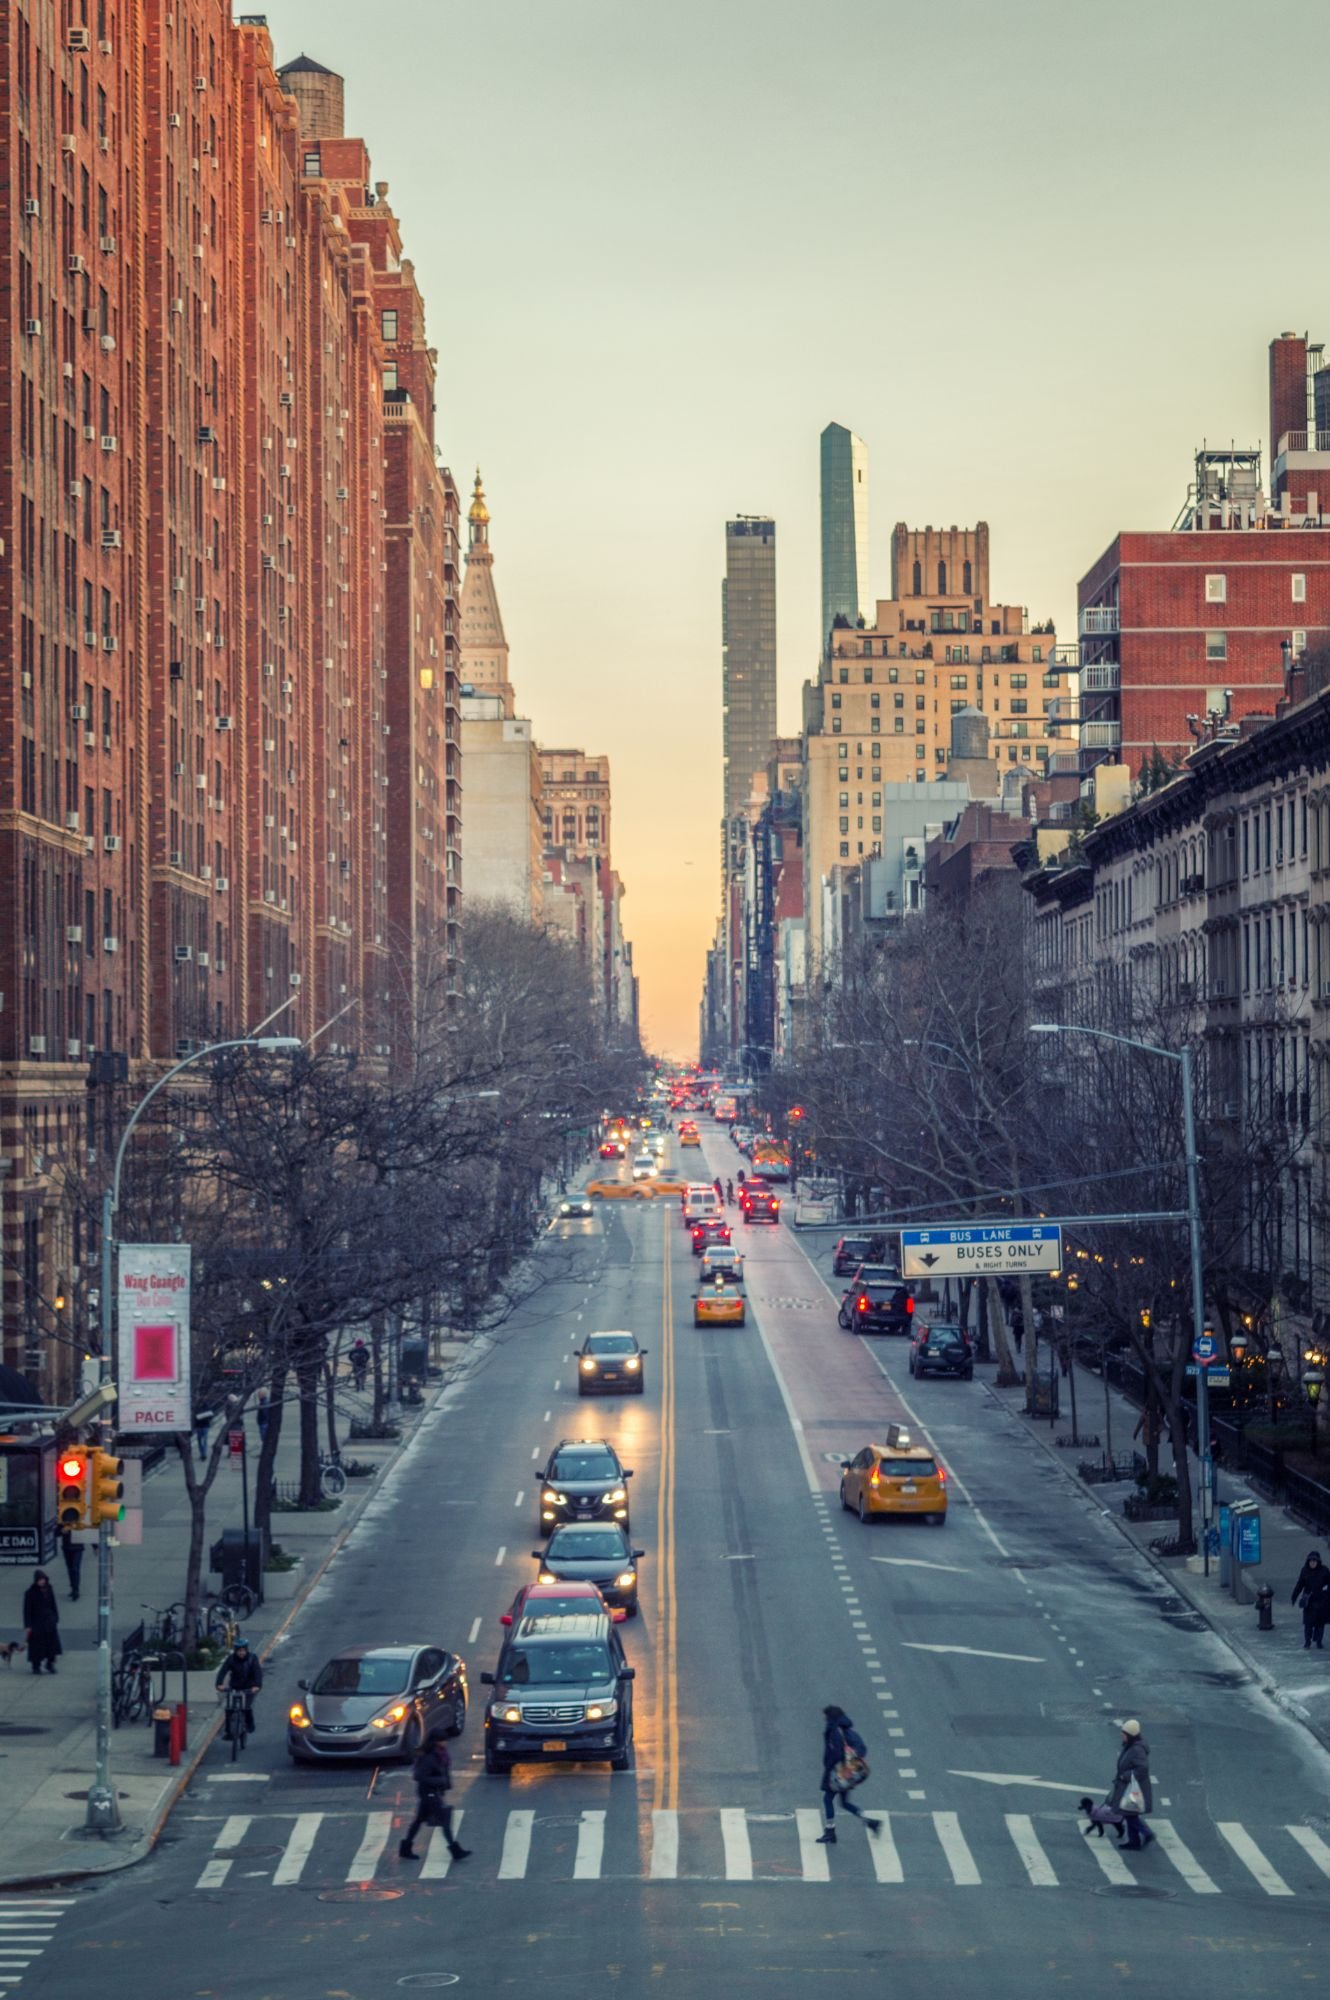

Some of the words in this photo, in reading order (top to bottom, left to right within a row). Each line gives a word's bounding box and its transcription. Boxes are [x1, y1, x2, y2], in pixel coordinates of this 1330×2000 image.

[950, 1231, 971, 1242] BUS
[982, 1230, 1011, 1240] LANE
[957, 1246, 1003, 1259] BUSES
[1008, 1244, 1044, 1257] ONLY
[983, 1261, 1002, 1269] RIGHT
[124, 1274, 148, 1292] Wang
[135, 1411, 175, 1423] PACE
